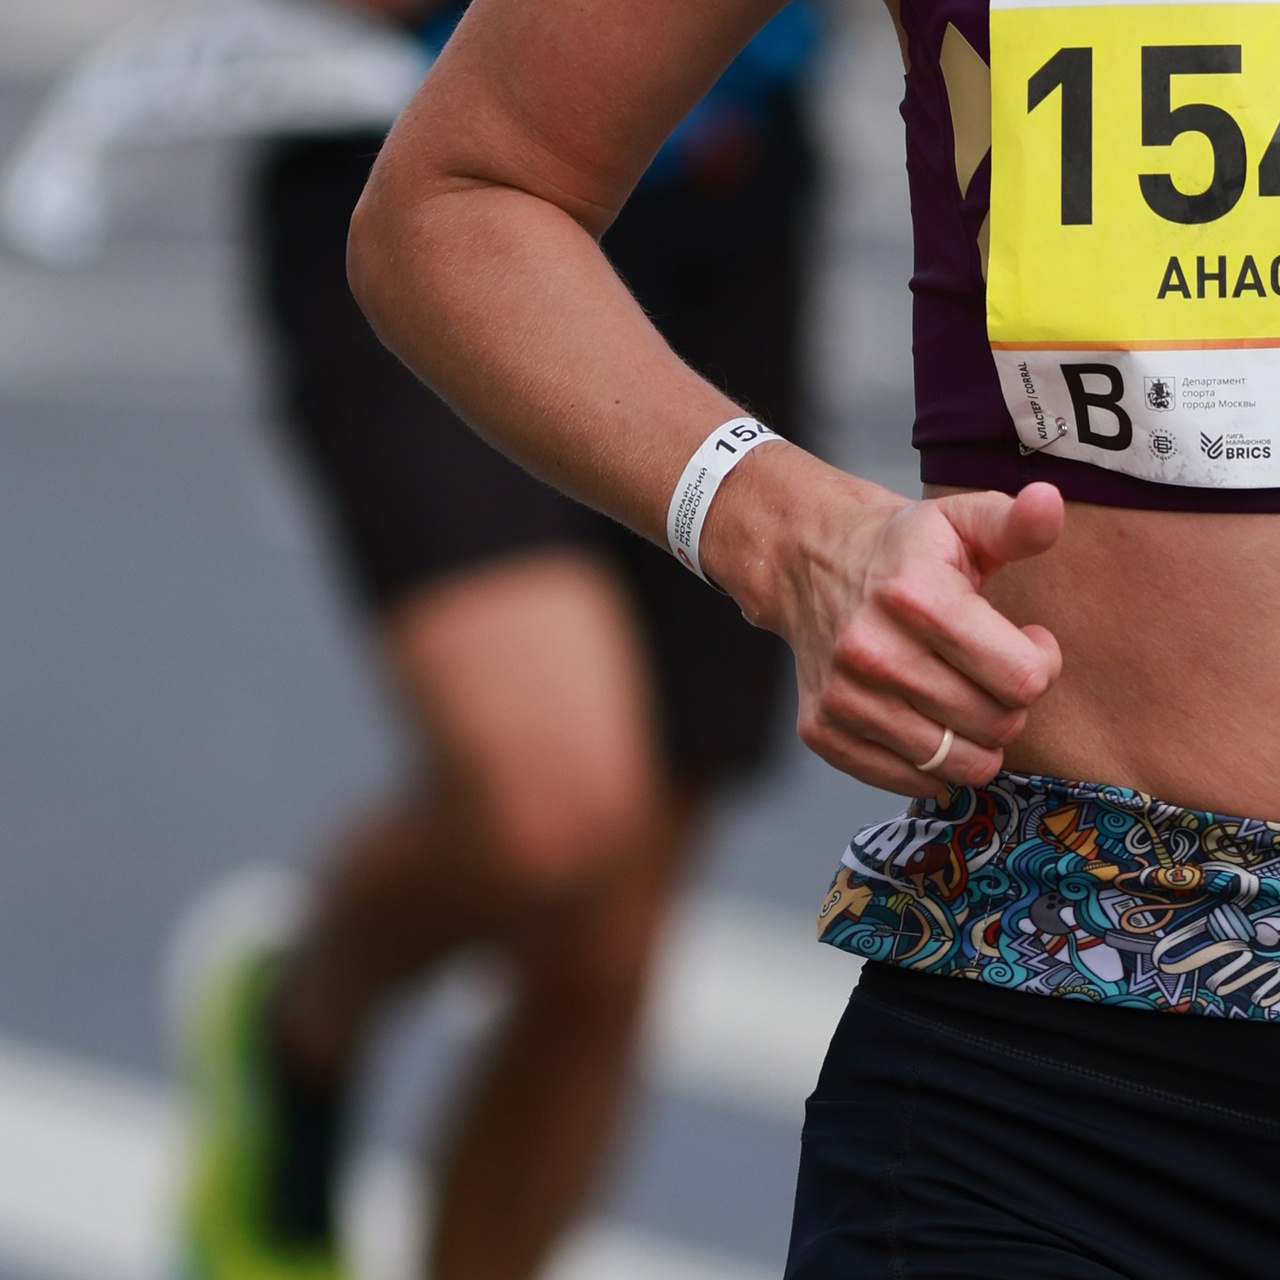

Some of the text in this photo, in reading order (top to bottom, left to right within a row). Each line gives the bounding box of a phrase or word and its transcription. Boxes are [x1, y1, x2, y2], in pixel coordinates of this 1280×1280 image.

[1018, 362, 1036, 395] CORRAL
[1181, 378, 1246, 387] Департамент
[1182, 390, 1215, 399] спорта
[1030, 401, 1048, 440] КЛАСТЕР
[1059, 363, 1133, 451] B
[1182, 400, 1256, 410] города Москвы
[1225, 446, 1271, 460] BRICS
[674, 483, 693, 540] СБЕРПРАЙМ
[679, 466, 708, 544] МОСКОВСКИЙ
[684, 490, 704, 548] МАРАФОН
